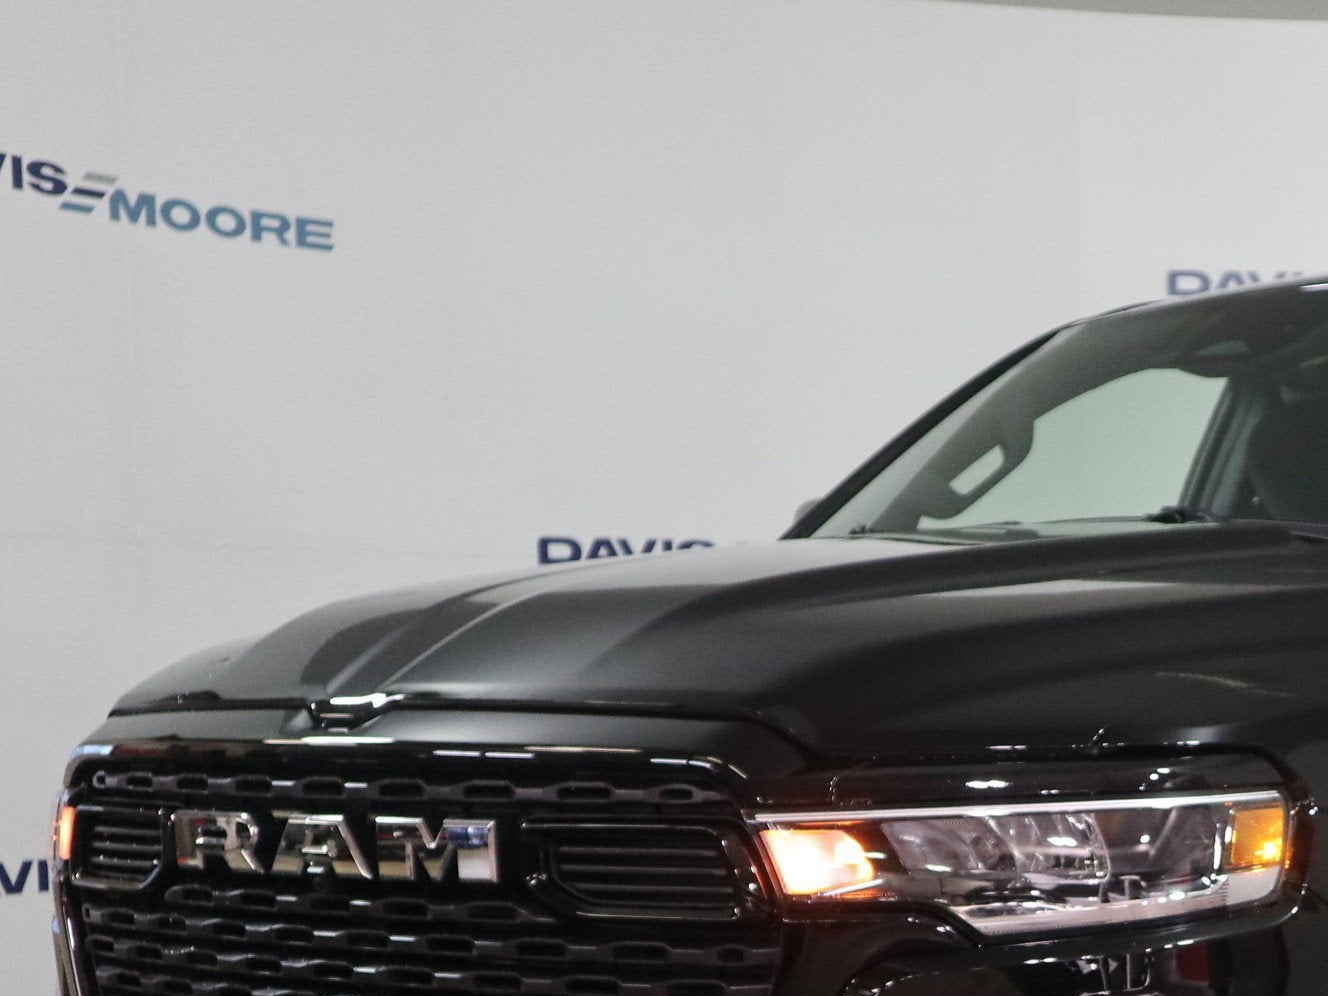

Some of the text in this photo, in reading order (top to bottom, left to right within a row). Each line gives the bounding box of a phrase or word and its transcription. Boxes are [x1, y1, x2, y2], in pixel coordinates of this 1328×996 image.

[0, 153, 335, 251] IS MOORE
[172, 809, 499, 884] RAM
